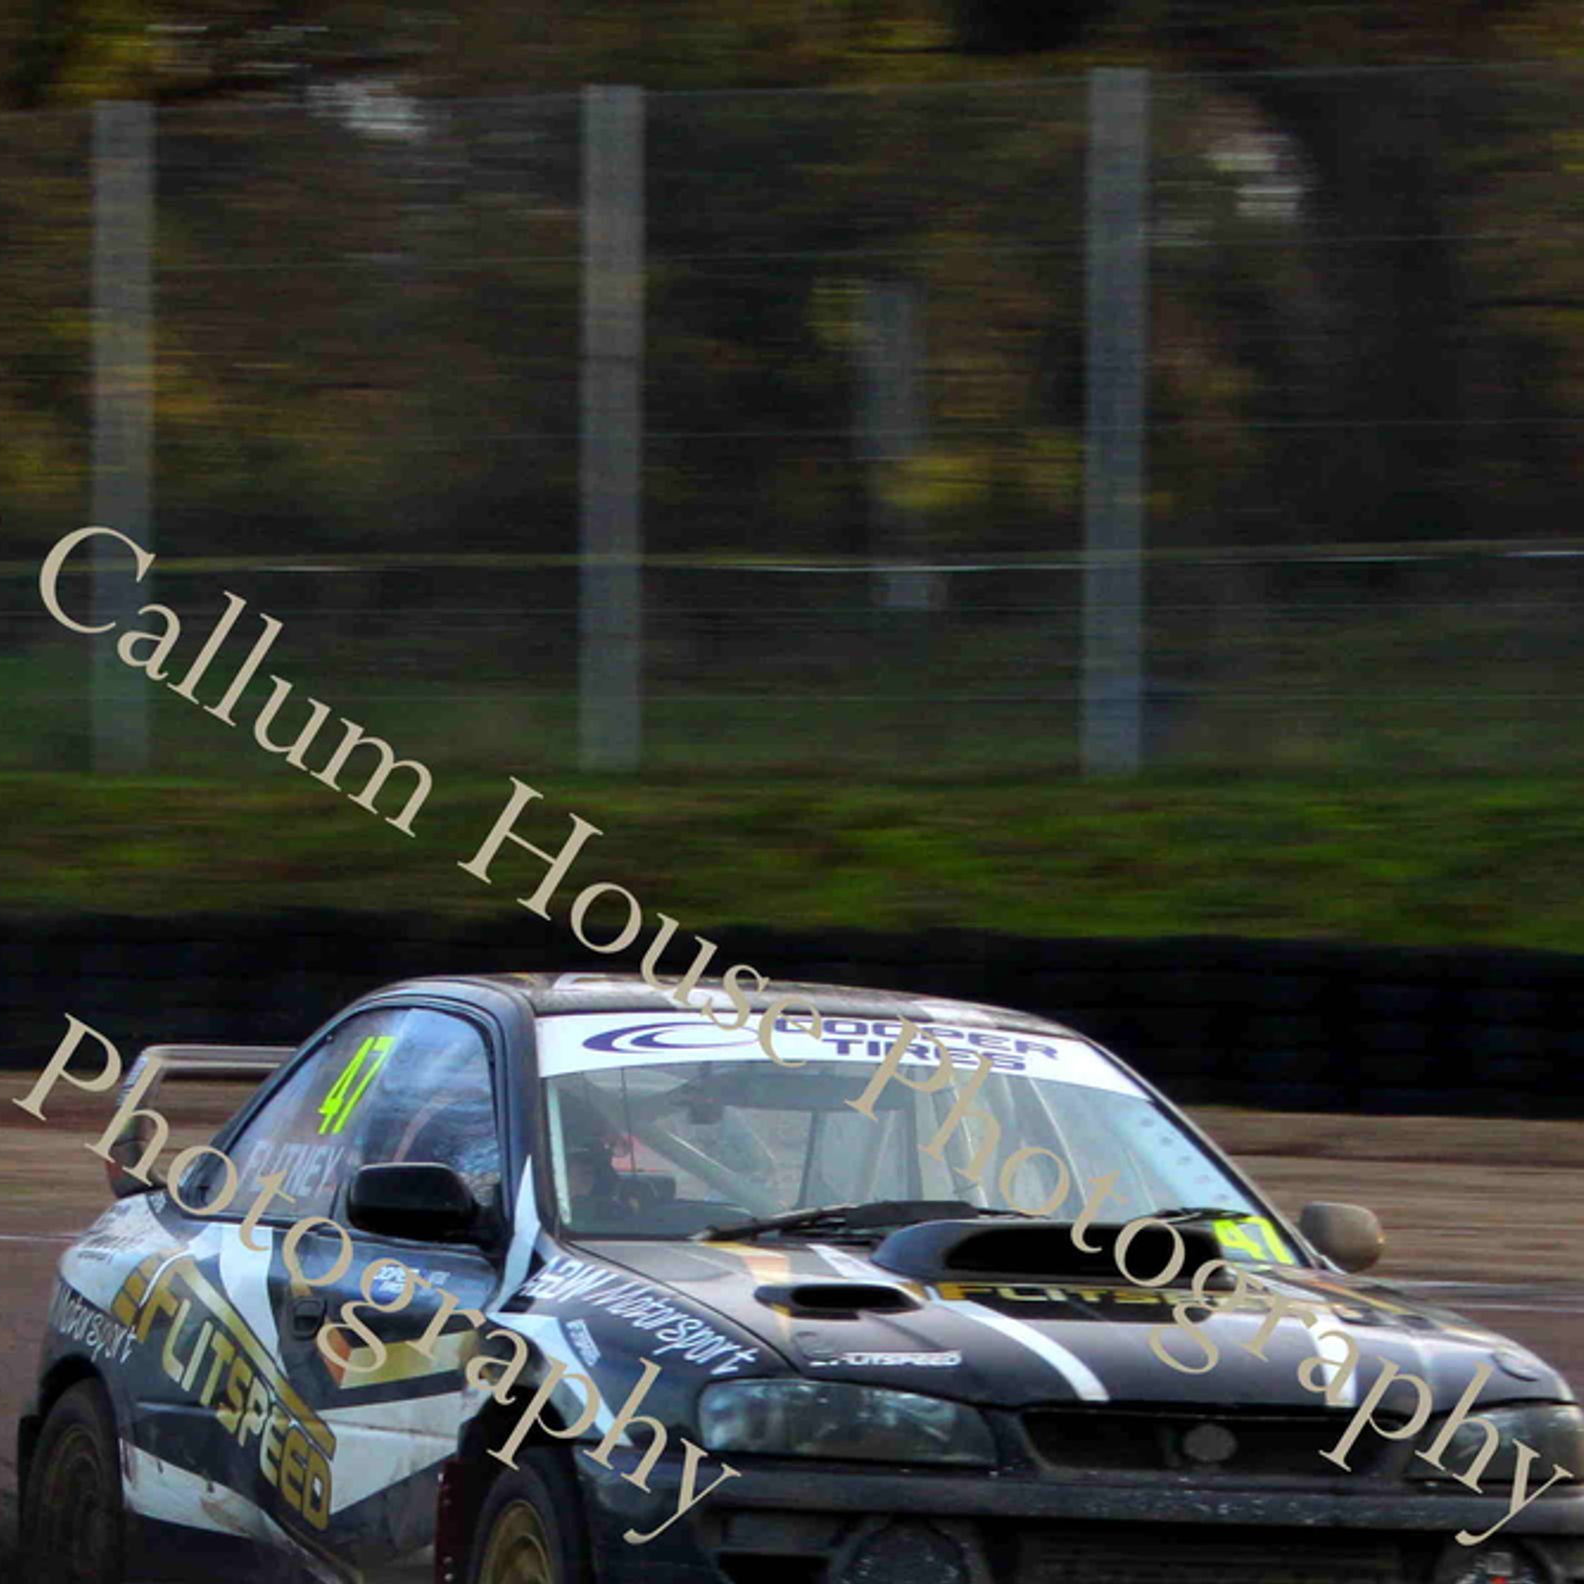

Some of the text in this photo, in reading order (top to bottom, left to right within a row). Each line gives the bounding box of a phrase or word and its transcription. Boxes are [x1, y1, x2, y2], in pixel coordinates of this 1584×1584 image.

[774, 1017, 1057, 1061] COOPER
[821, 1037, 1026, 1071] TIRES
[318, 1036, 395, 1135] 47
[1214, 1216, 1296, 1265] 47
[938, 1282, 1309, 1314] FLITSP
[584, 1280, 758, 1374] Motorsport
[130, 1252, 336, 1530] FLITSPEED
